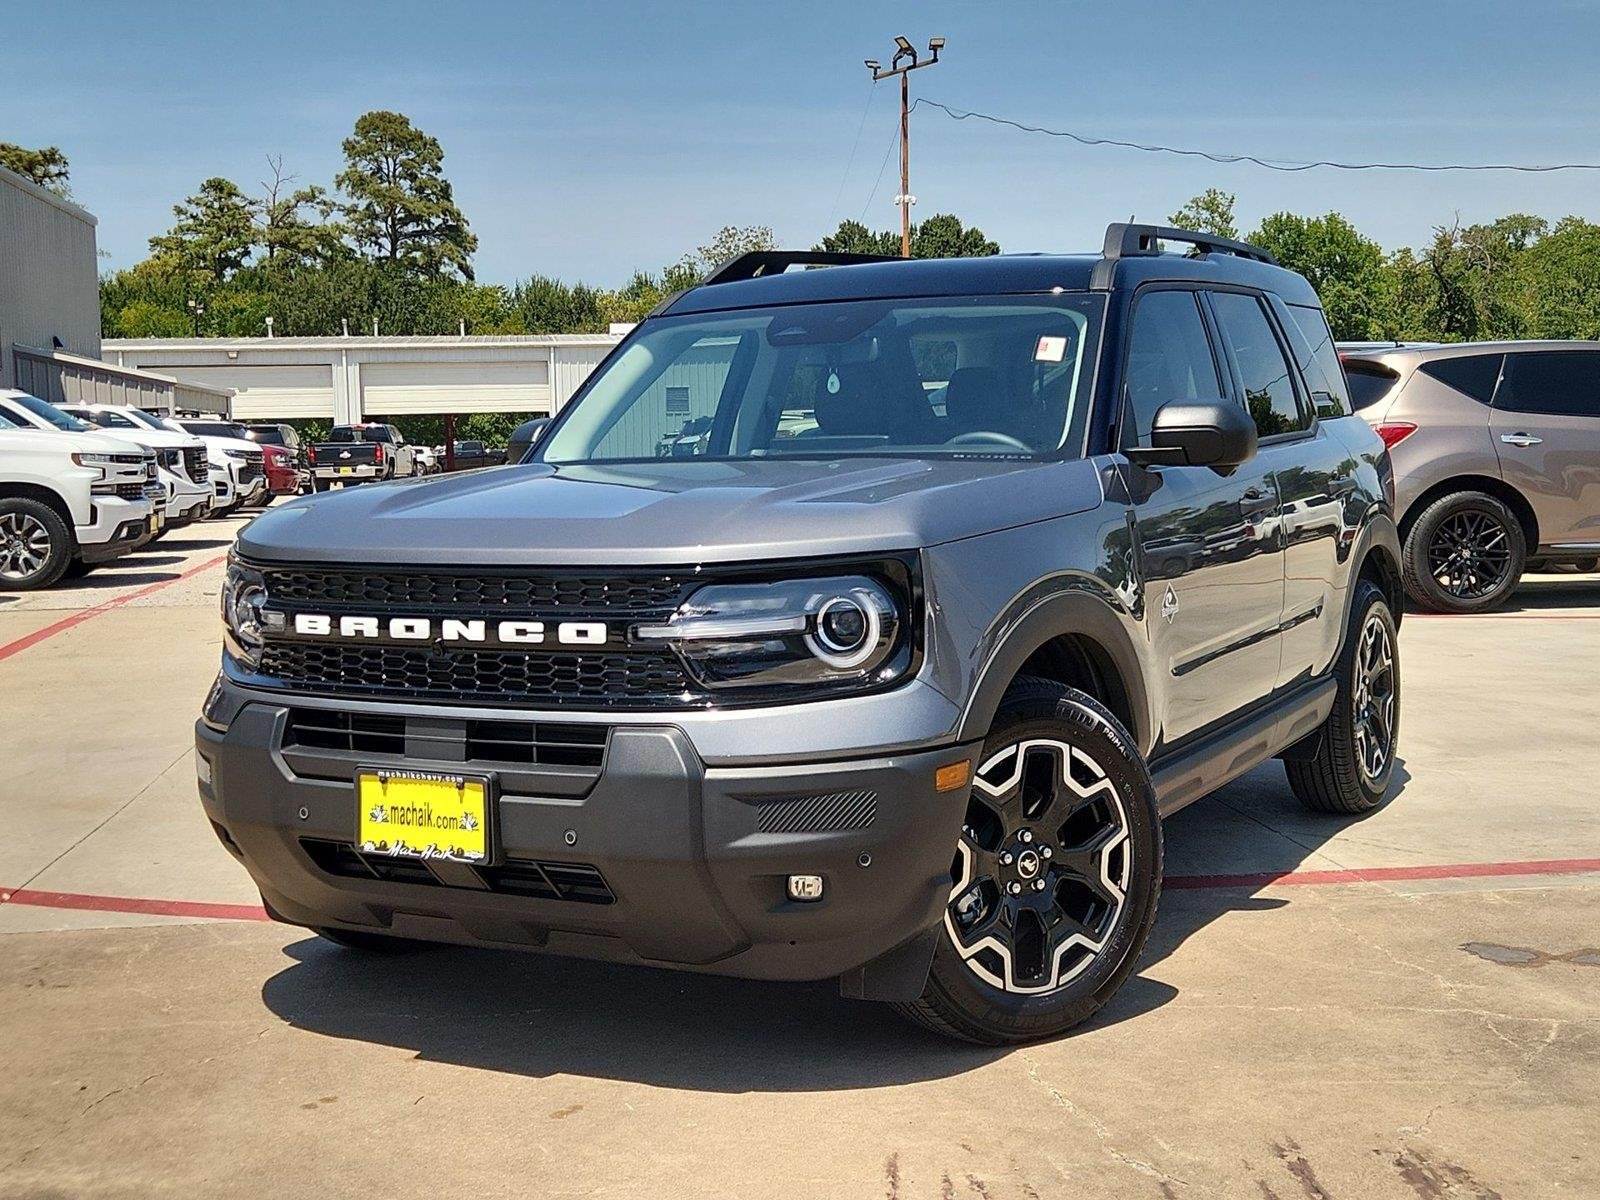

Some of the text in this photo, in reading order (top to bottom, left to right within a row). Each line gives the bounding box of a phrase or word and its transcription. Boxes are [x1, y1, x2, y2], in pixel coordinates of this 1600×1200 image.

[295, 614, 607, 645] BRONCO
[1102, 726, 1132, 761] PRIMA
[377, 771, 464, 783] machaikchevy.com
[390, 801, 458, 830] machaik.com
[387, 841, 420, 857] Mac
